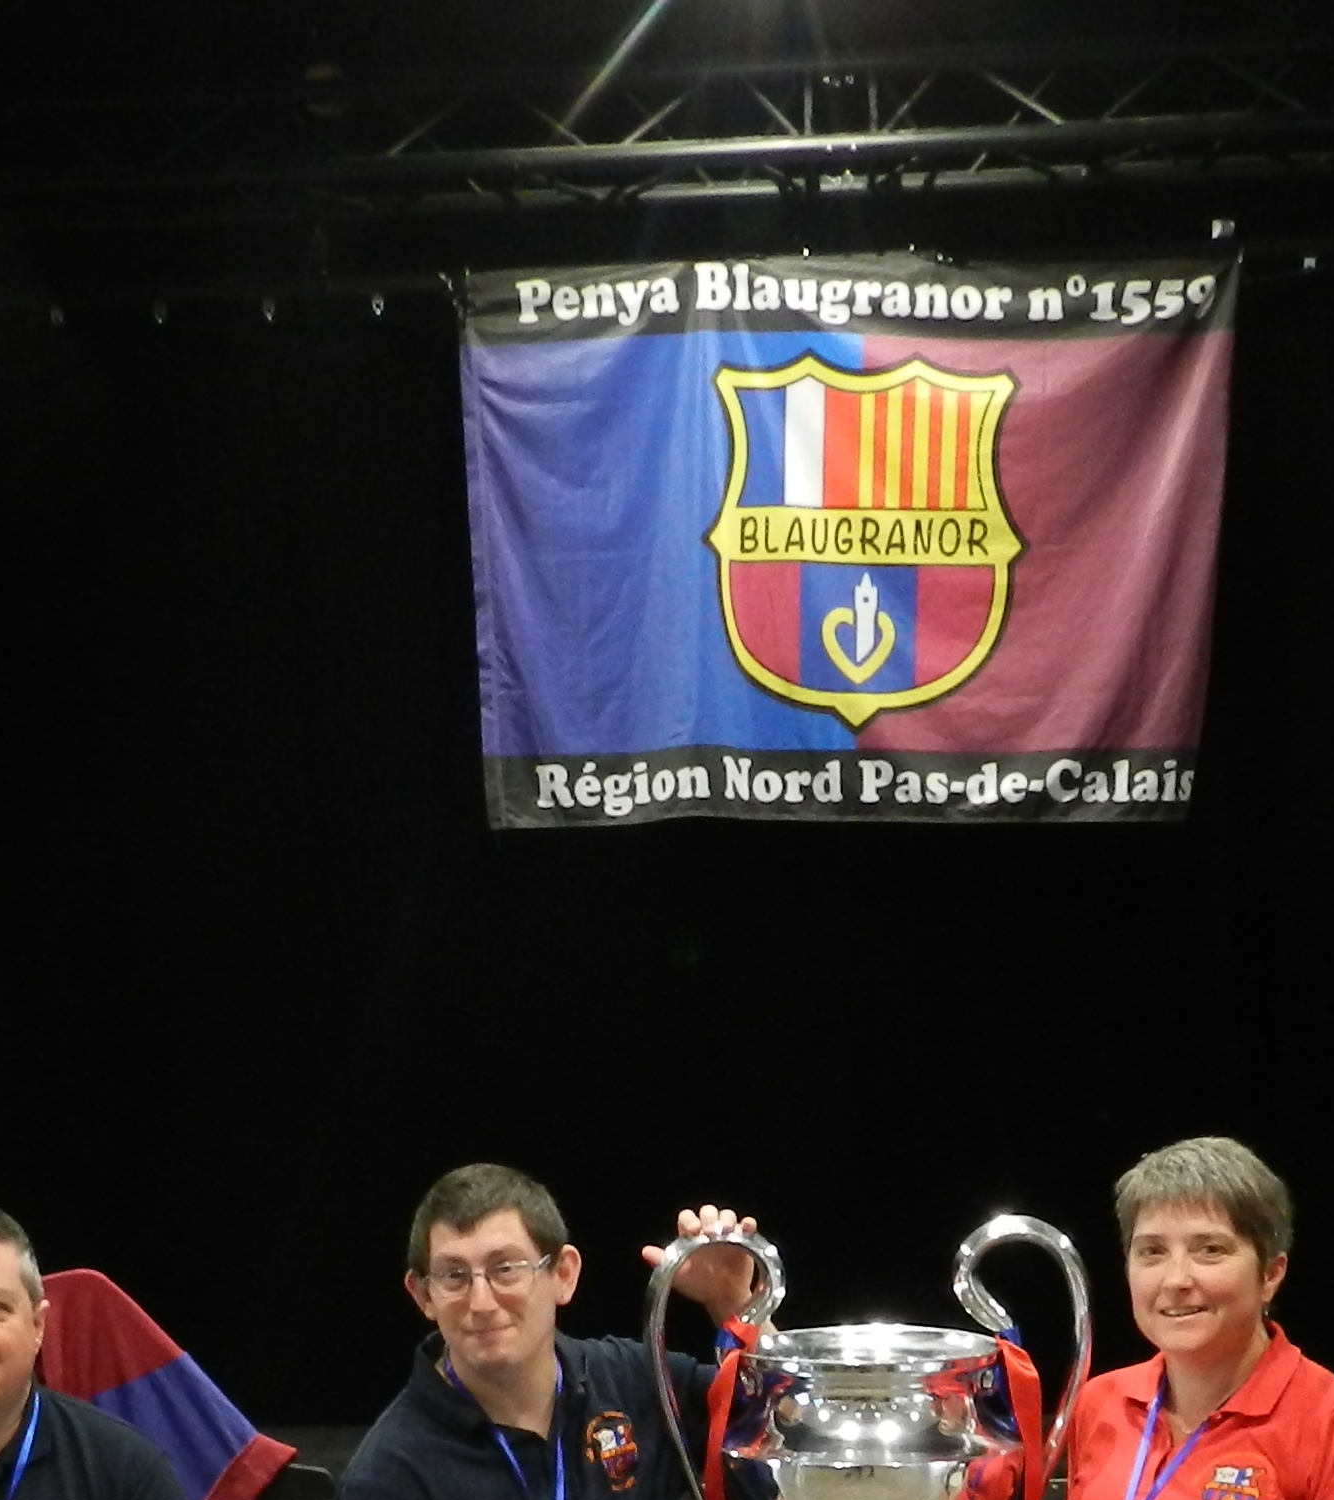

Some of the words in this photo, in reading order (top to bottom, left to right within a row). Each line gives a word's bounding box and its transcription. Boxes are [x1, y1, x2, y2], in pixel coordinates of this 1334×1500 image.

[516, 277, 681, 326] Penya
[693, 261, 1013, 325] Blaugranor
[739, 516, 989, 556] BLAUGRANOR
[535, 761, 711, 817] Région
[722, 755, 844, 803] Nord
[857, 758, 1195, 804] Pas-de-Calais
